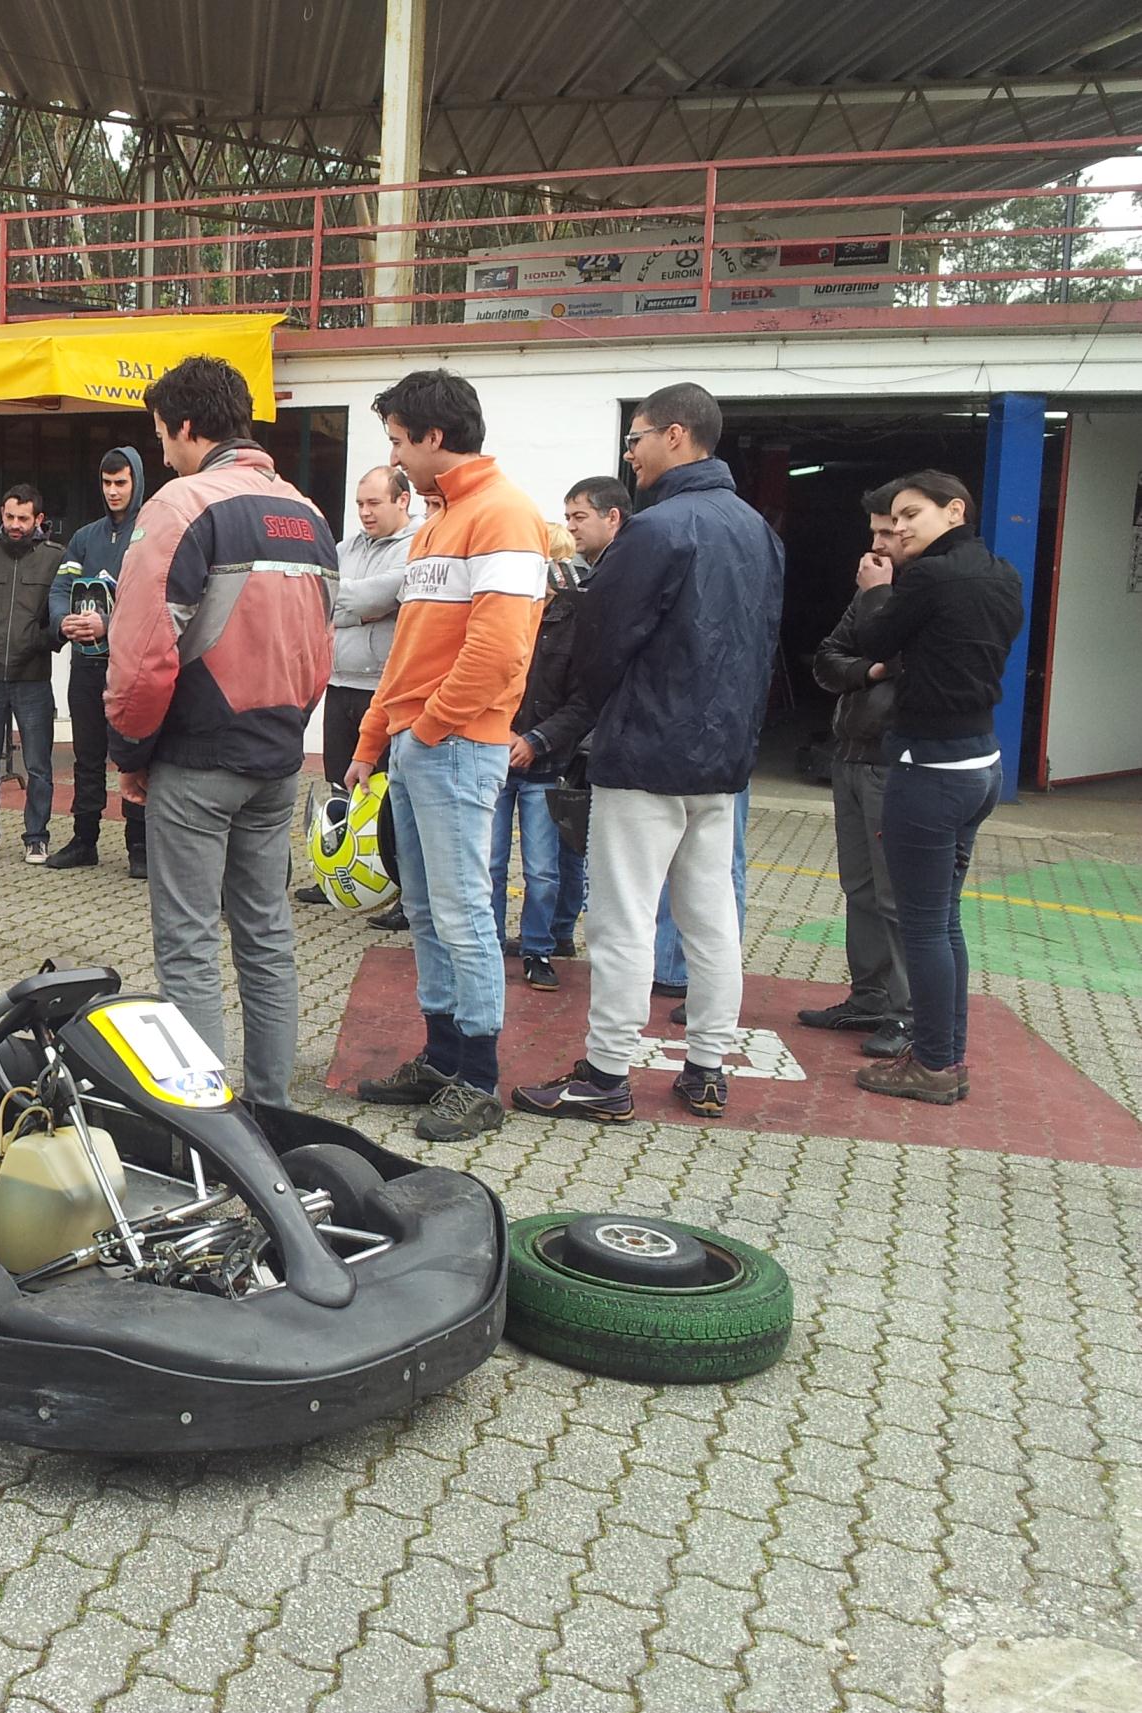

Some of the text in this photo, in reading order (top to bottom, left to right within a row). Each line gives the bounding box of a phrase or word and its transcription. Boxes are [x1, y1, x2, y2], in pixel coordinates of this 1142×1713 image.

[523, 270, 567, 281] HONDA
[731, 286, 776, 300] HELIX
[647, 298, 696, 308] MICHELIN
[262, 515, 315, 542] SHOEI
[139, 1014, 191, 1069] 1
